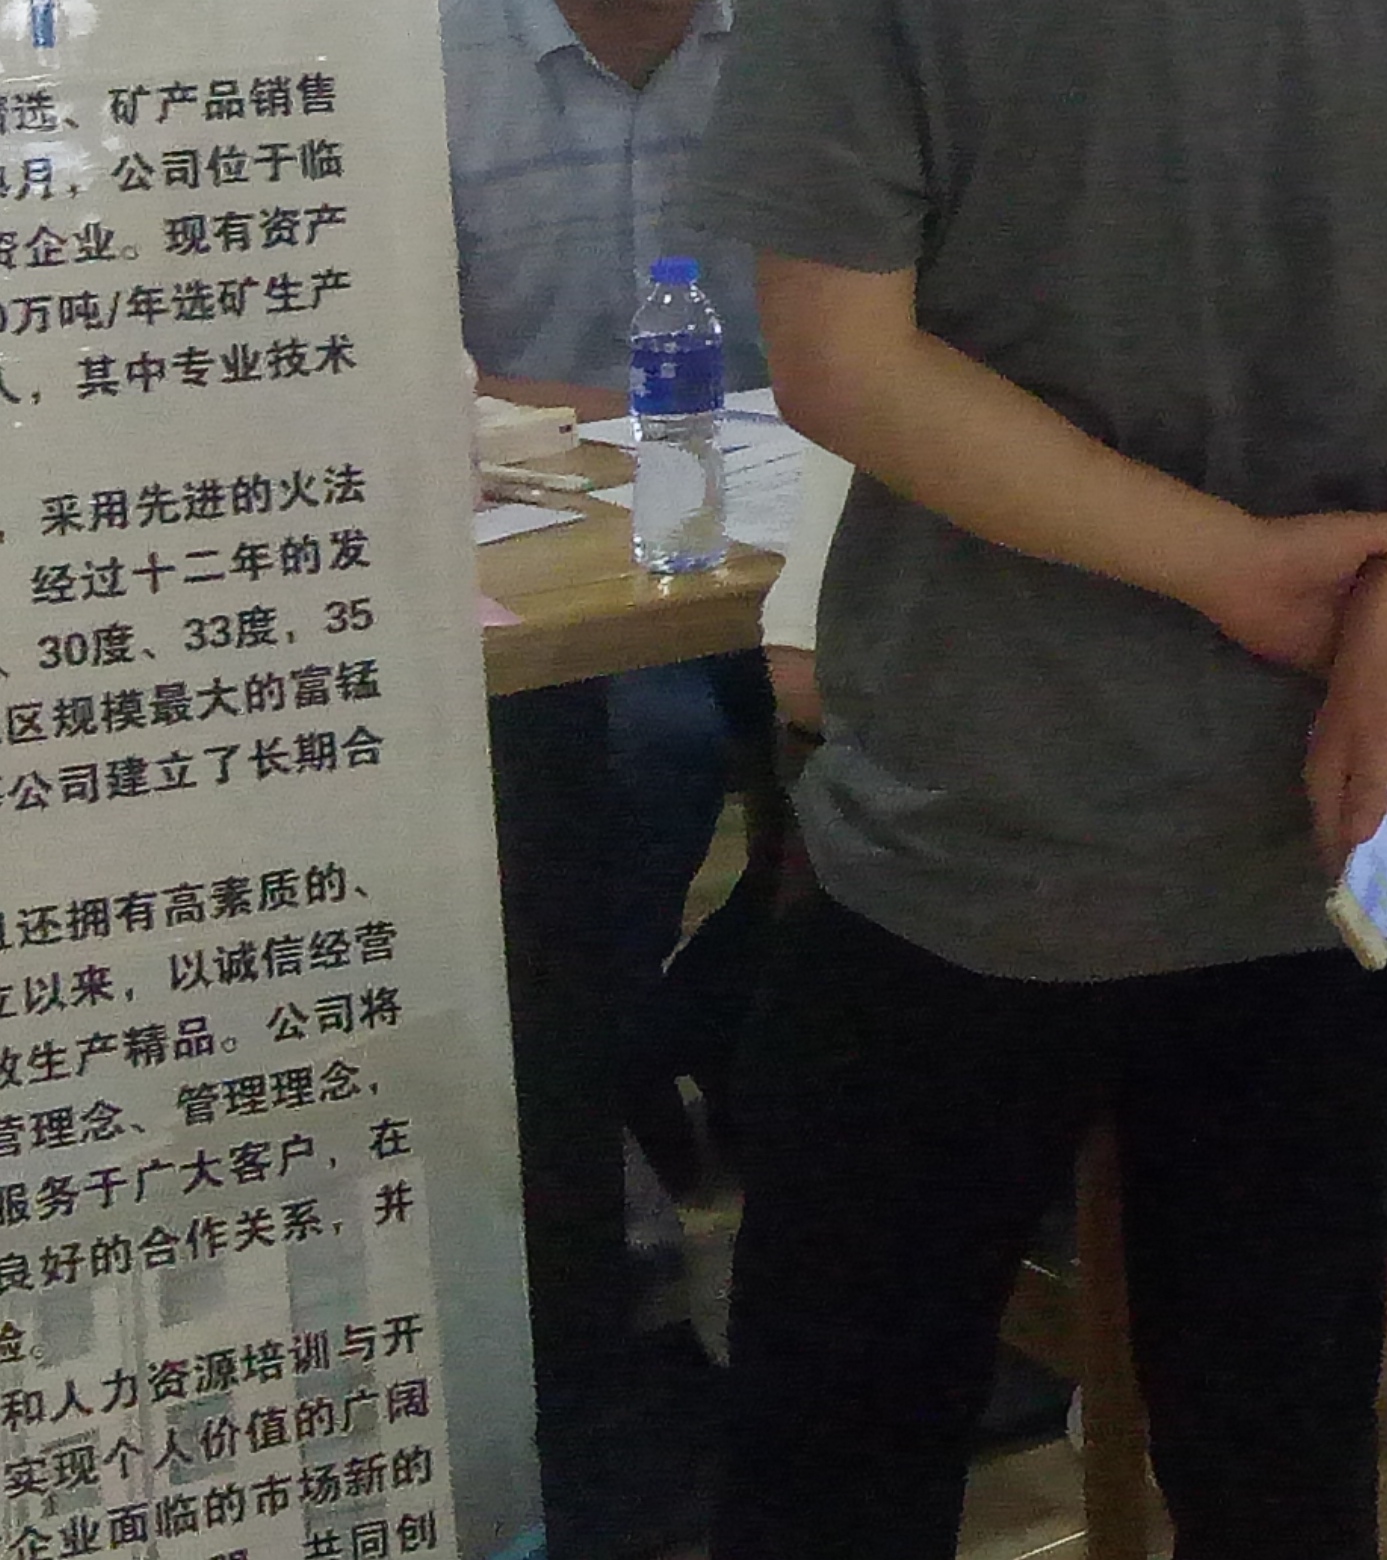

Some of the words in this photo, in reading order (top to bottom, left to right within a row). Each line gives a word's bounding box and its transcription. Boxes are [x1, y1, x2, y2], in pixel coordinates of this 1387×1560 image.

[0, 72, 337, 136] 选、矿产品销售
[0, 139, 347, 201] 月，公司位于临
[0, 266, 351, 337] 万吨/年选矿生产
[30, 524, 371, 606] 经过十二年的发
[0, 724, 385, 812] 公司建立了长期合
[2, 1313, 423, 1433] 和人力资源培训与开
